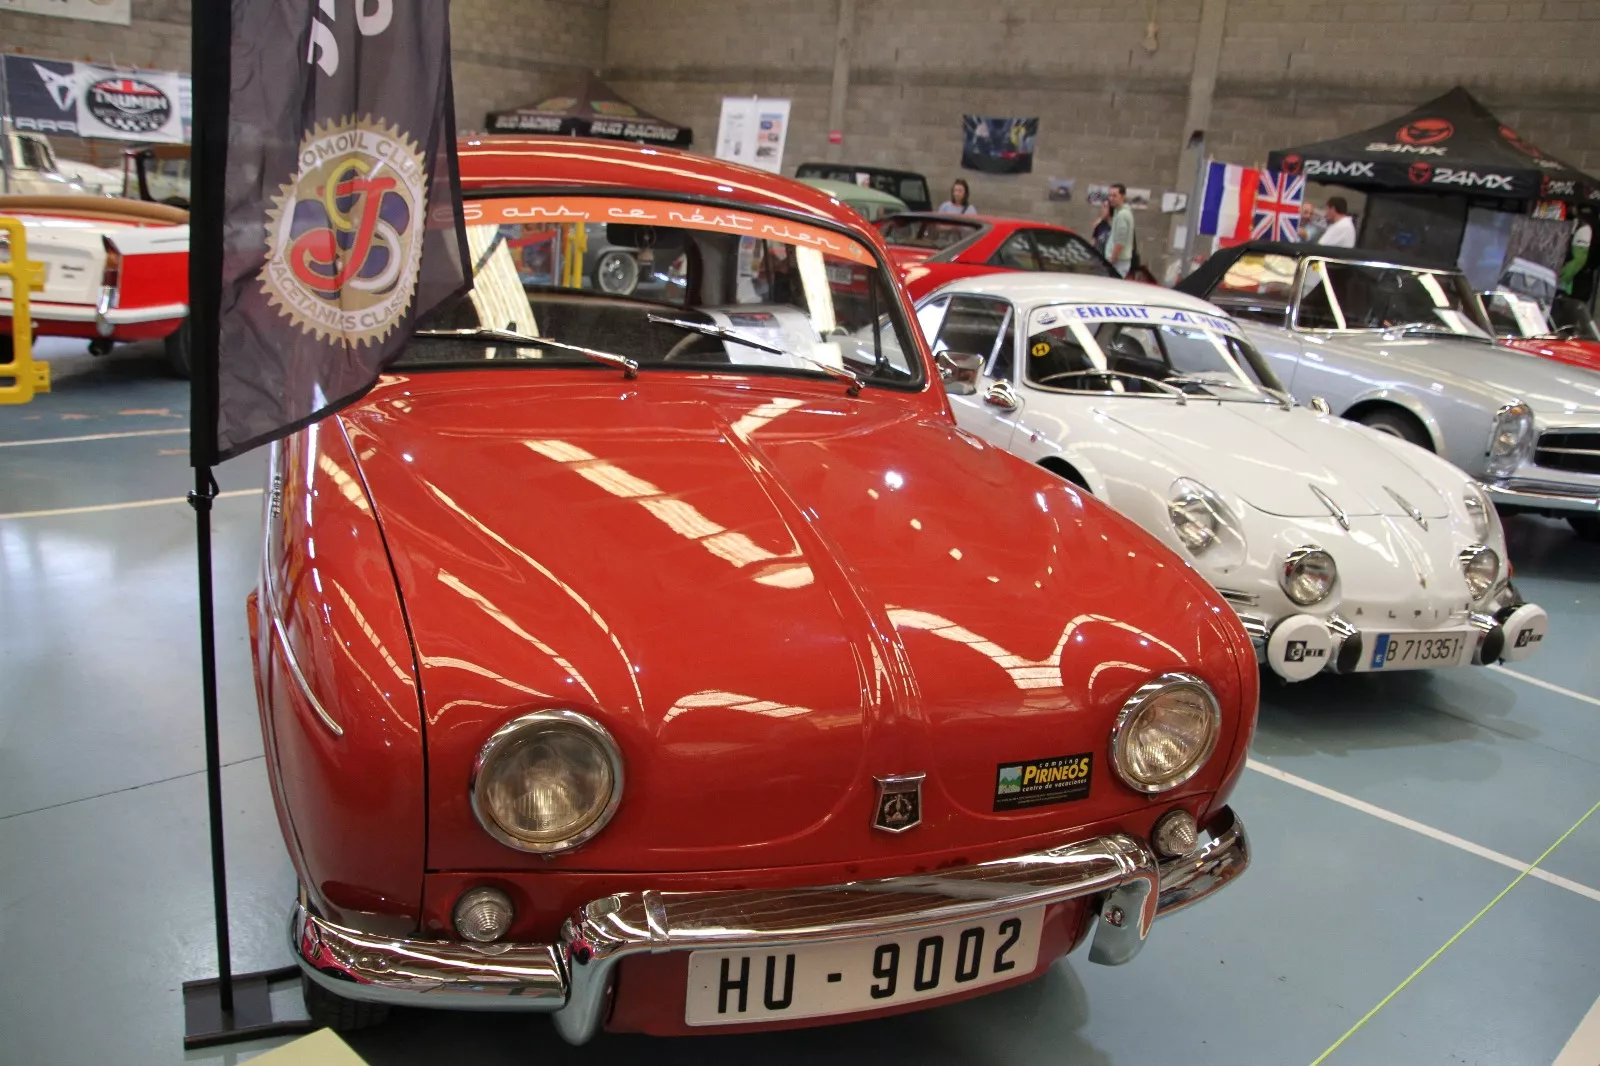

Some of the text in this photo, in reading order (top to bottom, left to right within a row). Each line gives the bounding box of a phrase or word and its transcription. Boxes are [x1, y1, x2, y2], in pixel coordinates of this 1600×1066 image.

[1304, 160, 1374, 177] 24MX
[1432, 168, 1514, 190] 24MX
[608, 207, 657, 219] ce
[761, 224, 840, 251] rien
[1063, 306, 1149, 319] RENAULT
[1386, 638, 1459, 661] B 713351
[1023, 758, 1089, 785] PIRINEOS
[1040, 758, 1079, 768] camping
[1022, 784, 1042, 792] centro
[1054, 779, 1087, 788] vacaciones
[718, 954, 796, 1014] HU
[870, 917, 1022, 999] 9002
